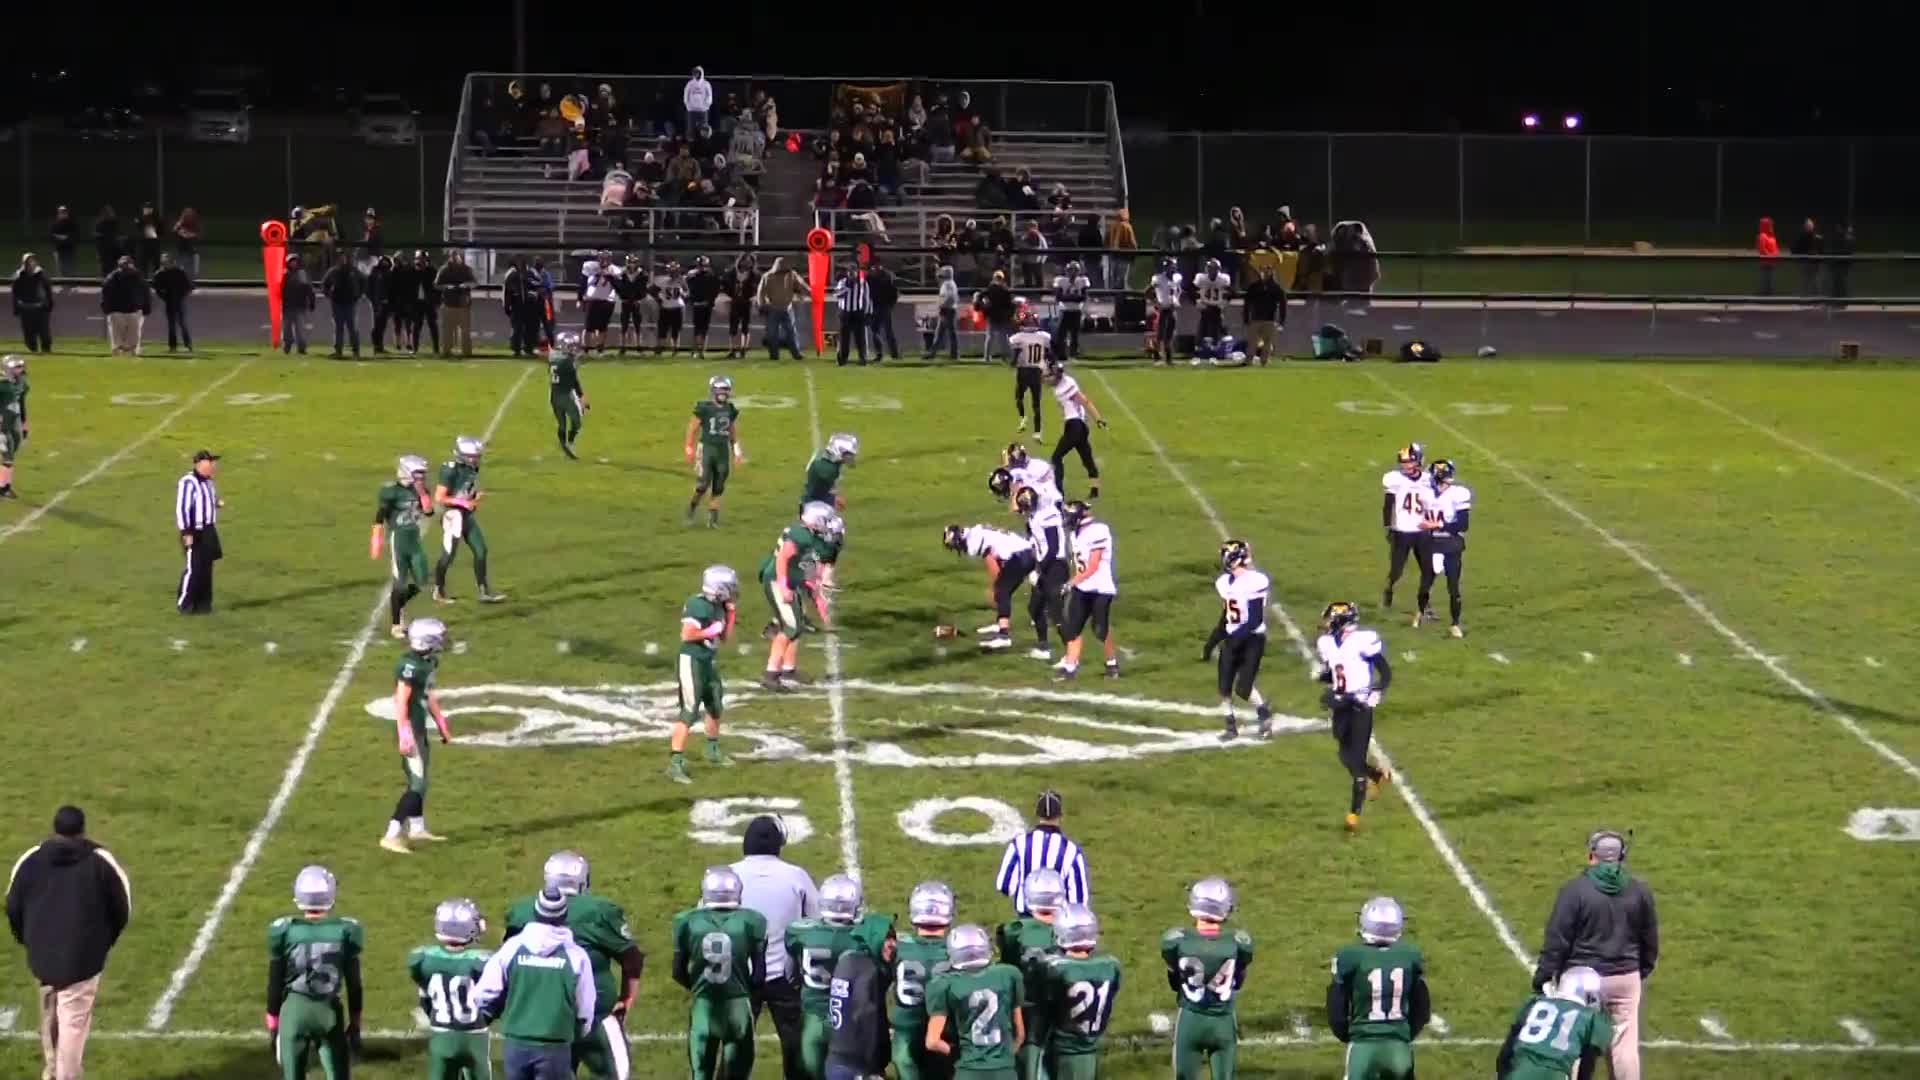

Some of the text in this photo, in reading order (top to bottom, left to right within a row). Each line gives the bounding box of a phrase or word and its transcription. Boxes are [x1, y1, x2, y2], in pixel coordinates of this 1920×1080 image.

[1028, 343, 1042, 364] 10
[709, 415, 730, 435] 12
[1402, 492, 1424, 514] 45
[702, 932, 733, 984] 9
[1179, 957, 1236, 1003] 34
[427, 972, 480, 1024] 40
[968, 988, 1001, 1045] 2
[1066, 980, 1110, 1032] 21
[1367, 967, 1404, 1020] 11
[1518, 1002, 1579, 1051] 81
